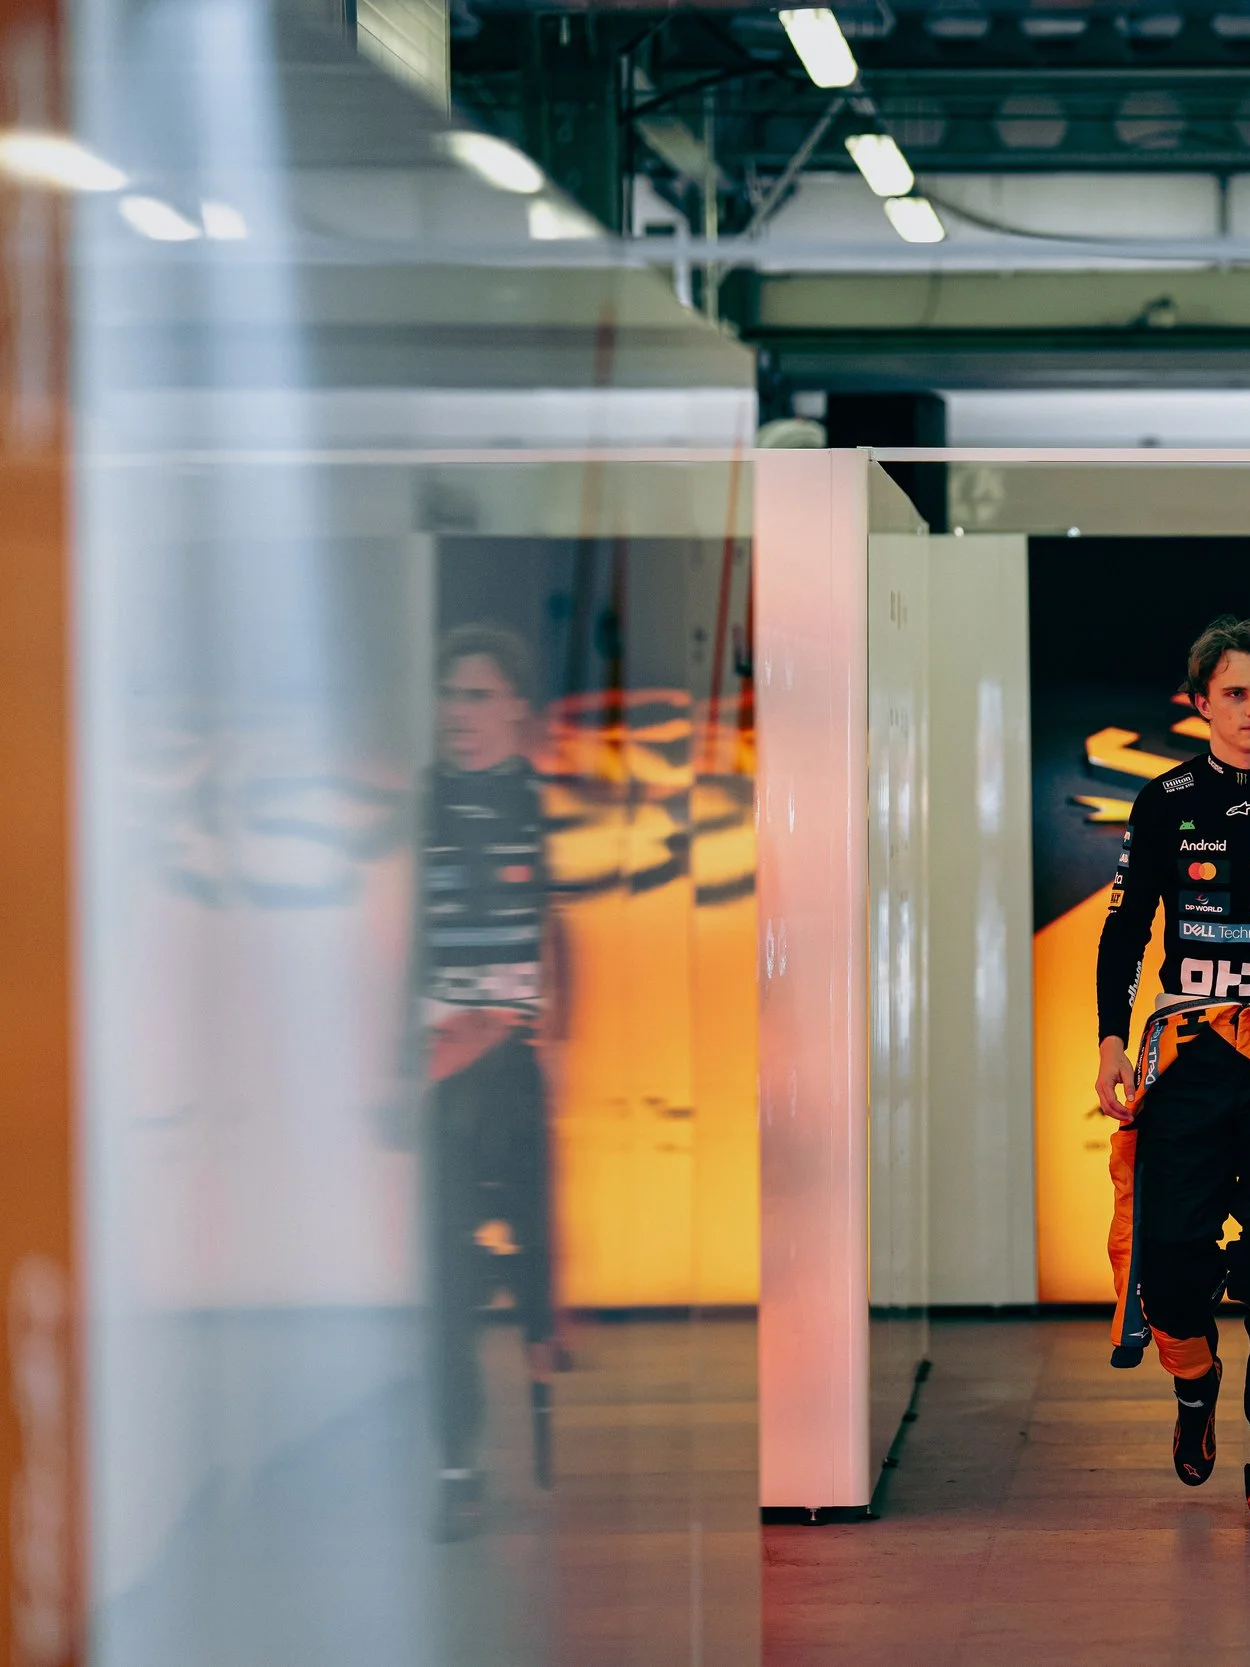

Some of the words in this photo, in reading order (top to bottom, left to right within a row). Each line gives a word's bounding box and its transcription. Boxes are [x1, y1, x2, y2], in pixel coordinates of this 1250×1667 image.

[1165, 776, 1191, 788] Hilton
[1179, 838, 1227, 852] Android
[1196, 905, 1223, 913] WORLD
[1183, 922, 1216, 938] DELL
[1146, 1046, 1157, 1085] DELL
